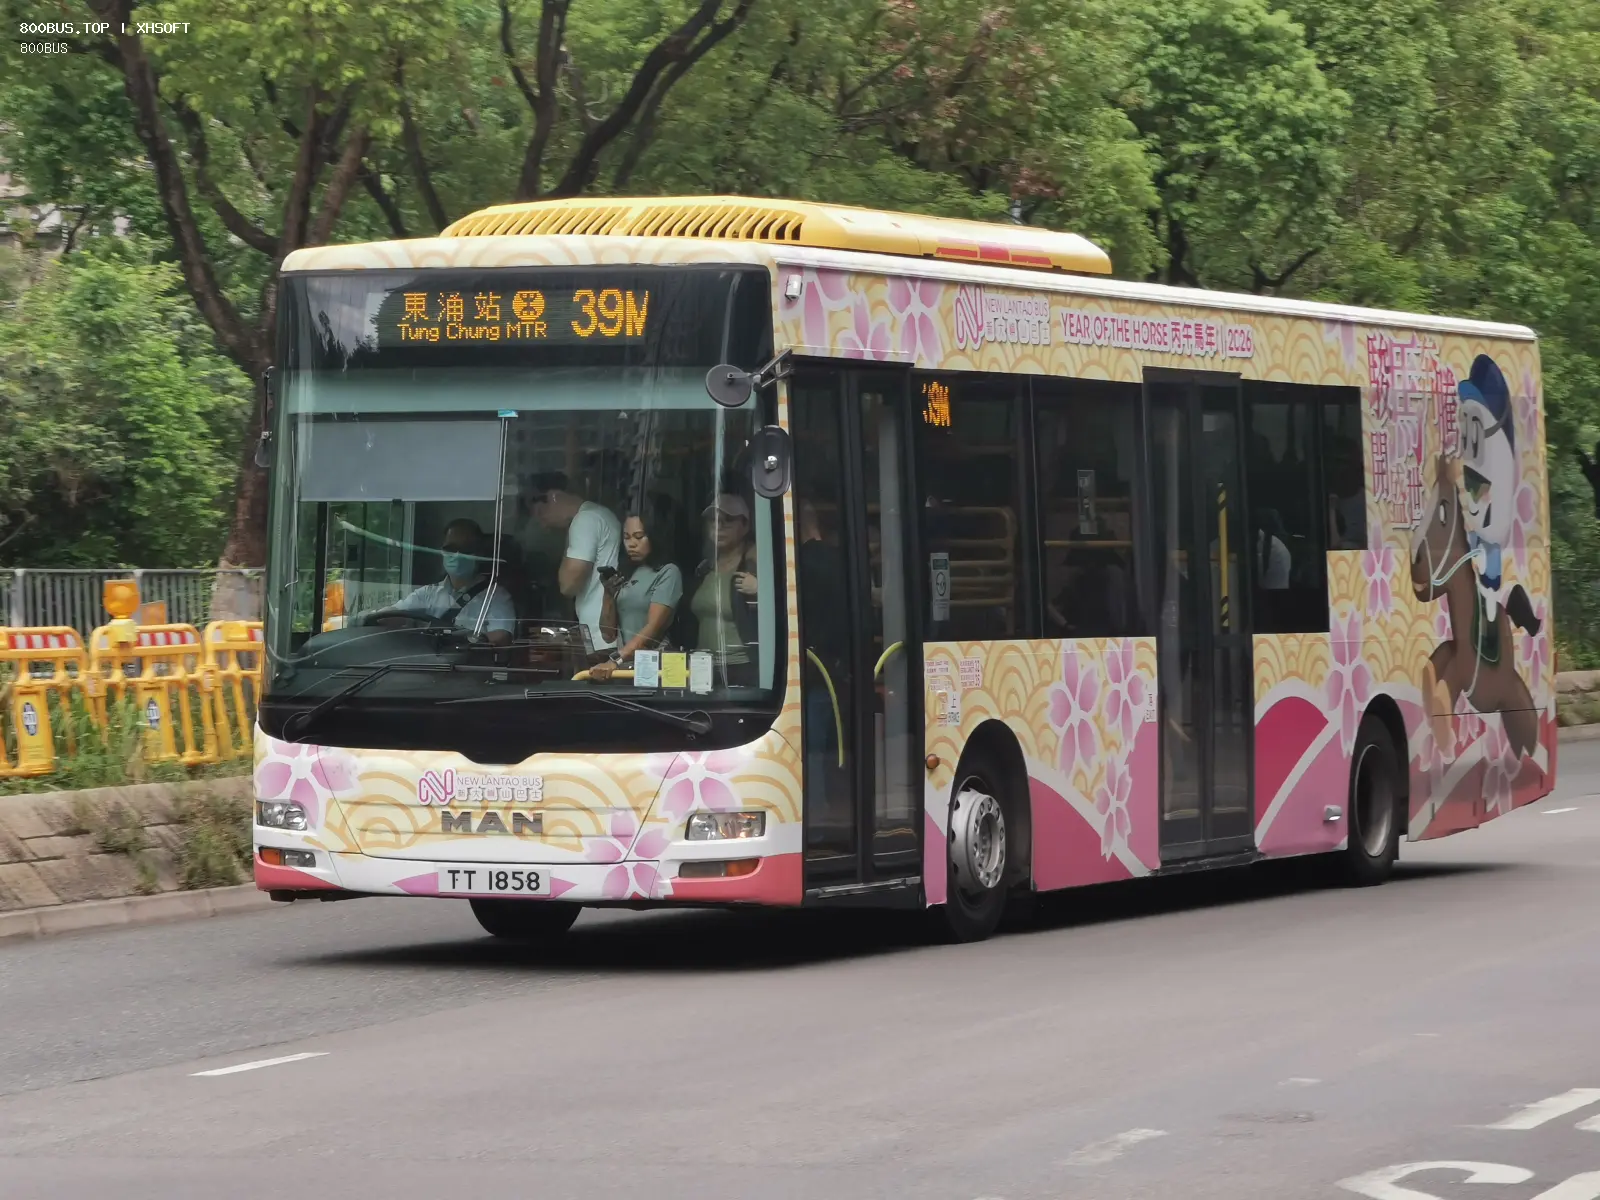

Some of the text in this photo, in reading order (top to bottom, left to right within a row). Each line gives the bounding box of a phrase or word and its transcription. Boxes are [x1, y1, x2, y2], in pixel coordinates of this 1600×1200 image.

[401, 288, 649, 338] 東涌站 39M
[984, 298, 1048, 317] NEW LANTAO BUS
[397, 321, 547, 342] Tung Chung MTR
[1061, 312, 1090, 338] YEAR
[1093, 316, 1108, 340] OF
[1110, 317, 1130, 342] THE
[1132, 320, 1168, 346] HORSE
[1227, 328, 1252, 352] 2026
[457, 776, 541, 787] NEW LANTAO BUS
[441, 810, 543, 834] MAN
[447, 869, 541, 892] TT 1858
